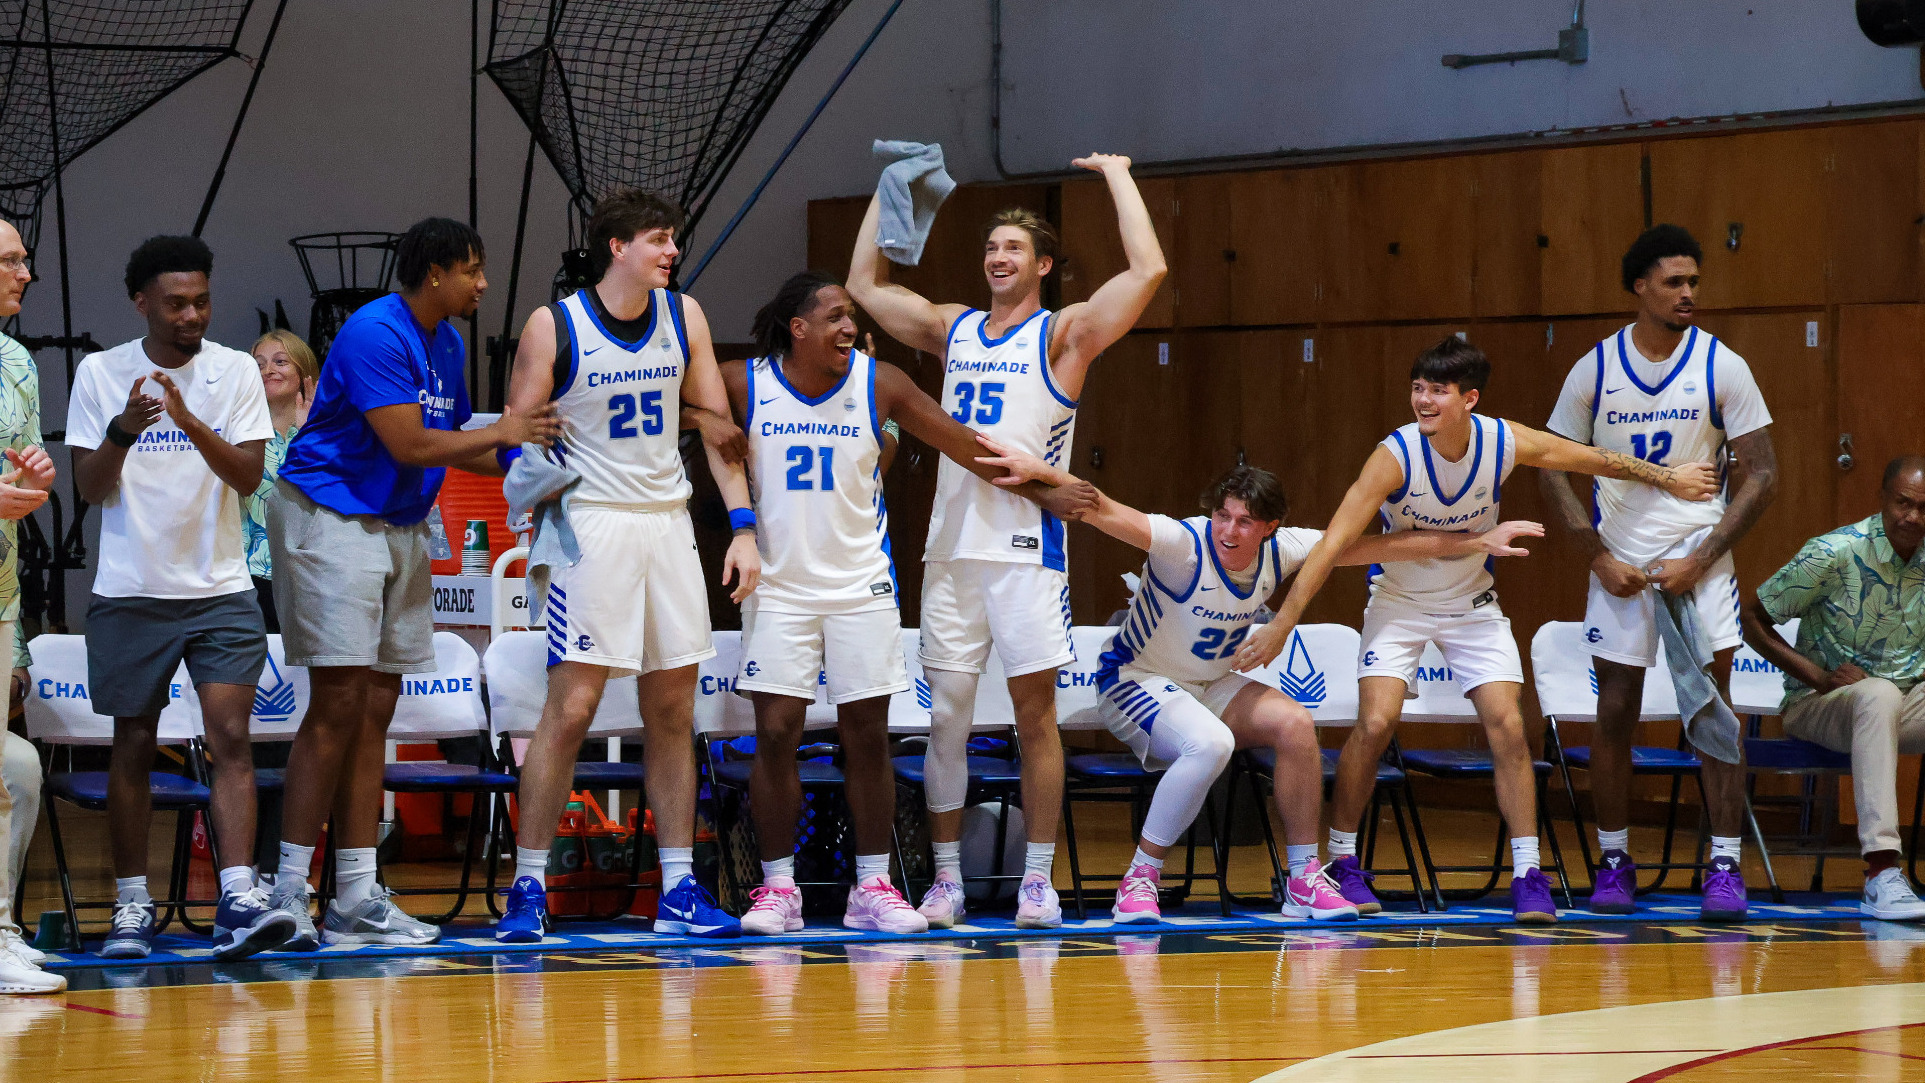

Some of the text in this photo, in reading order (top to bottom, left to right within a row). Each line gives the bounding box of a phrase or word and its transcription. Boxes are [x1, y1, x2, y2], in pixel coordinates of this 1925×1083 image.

[588, 366, 677, 387] CHAMINADE
[948, 359, 1029, 374] CHAMINADE
[951, 382, 1006, 425] 35
[608, 390, 664, 440] 25
[1607, 408, 1699, 425] CHAMINADE
[761, 421, 860, 438] CHAMINADE
[138, 444, 199, 453] BASKETBAL
[1630, 431, 1672, 467] 12
[785, 445, 834, 492] 21
[1402, 505, 1488, 526] CHAMINADE
[433, 587, 474, 612] ORADE
[1192, 606, 1257, 621] CHAMIN
[1191, 625, 1250, 660] 22
[399, 677, 473, 696] INADE
